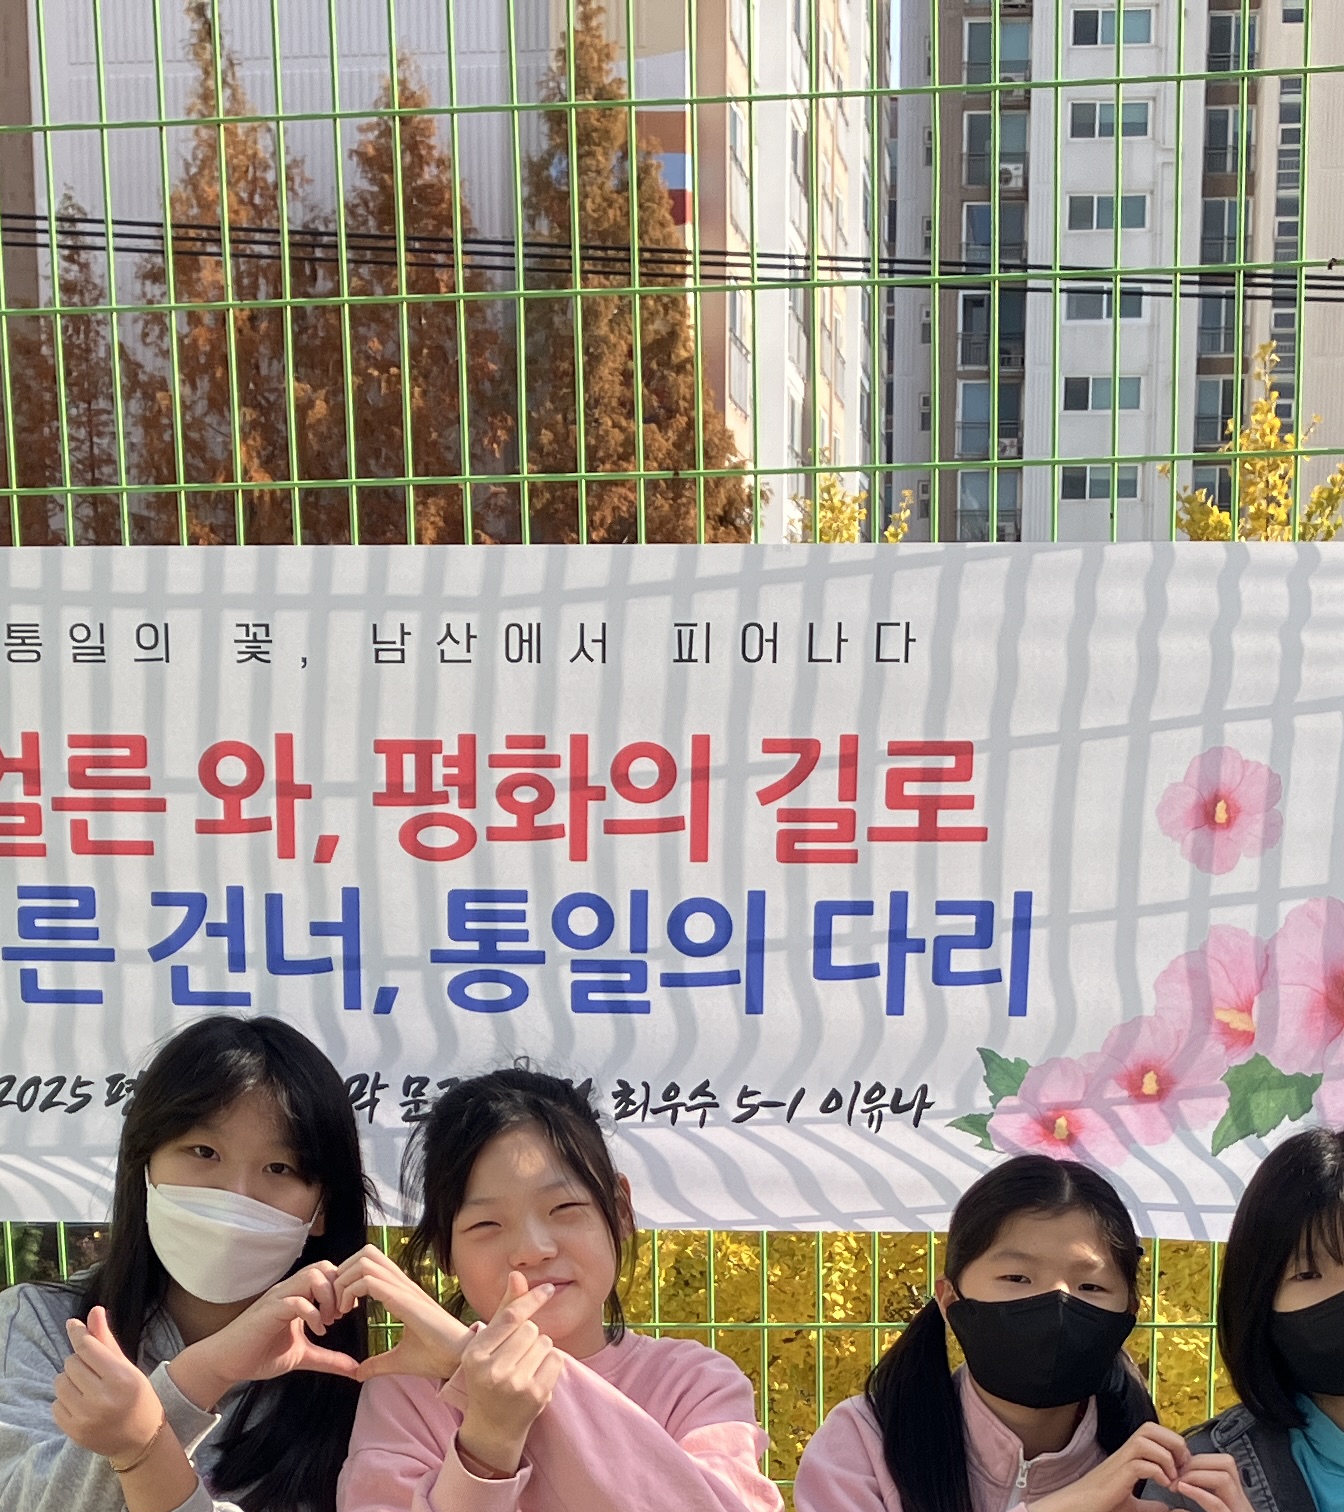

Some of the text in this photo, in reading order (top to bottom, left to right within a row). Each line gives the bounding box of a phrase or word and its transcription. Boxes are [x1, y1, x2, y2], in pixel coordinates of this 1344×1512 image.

[4, 621, 917, 669] 통일의 꽃, 남산에서 피어나다
[196, 732, 340, 864] 와,
[373, 733, 711, 864] 평화의
[757, 734, 989, 864] 길로
[148, 887, 397, 1015] 건너,
[431, 890, 766, 1015] 통일의
[813, 892, 1033, 1017] 다리
[611, 1078, 720, 1129] 최우수
[731, 1084, 806, 1124] 5-1
[819, 1080, 935, 1134] 이유나
